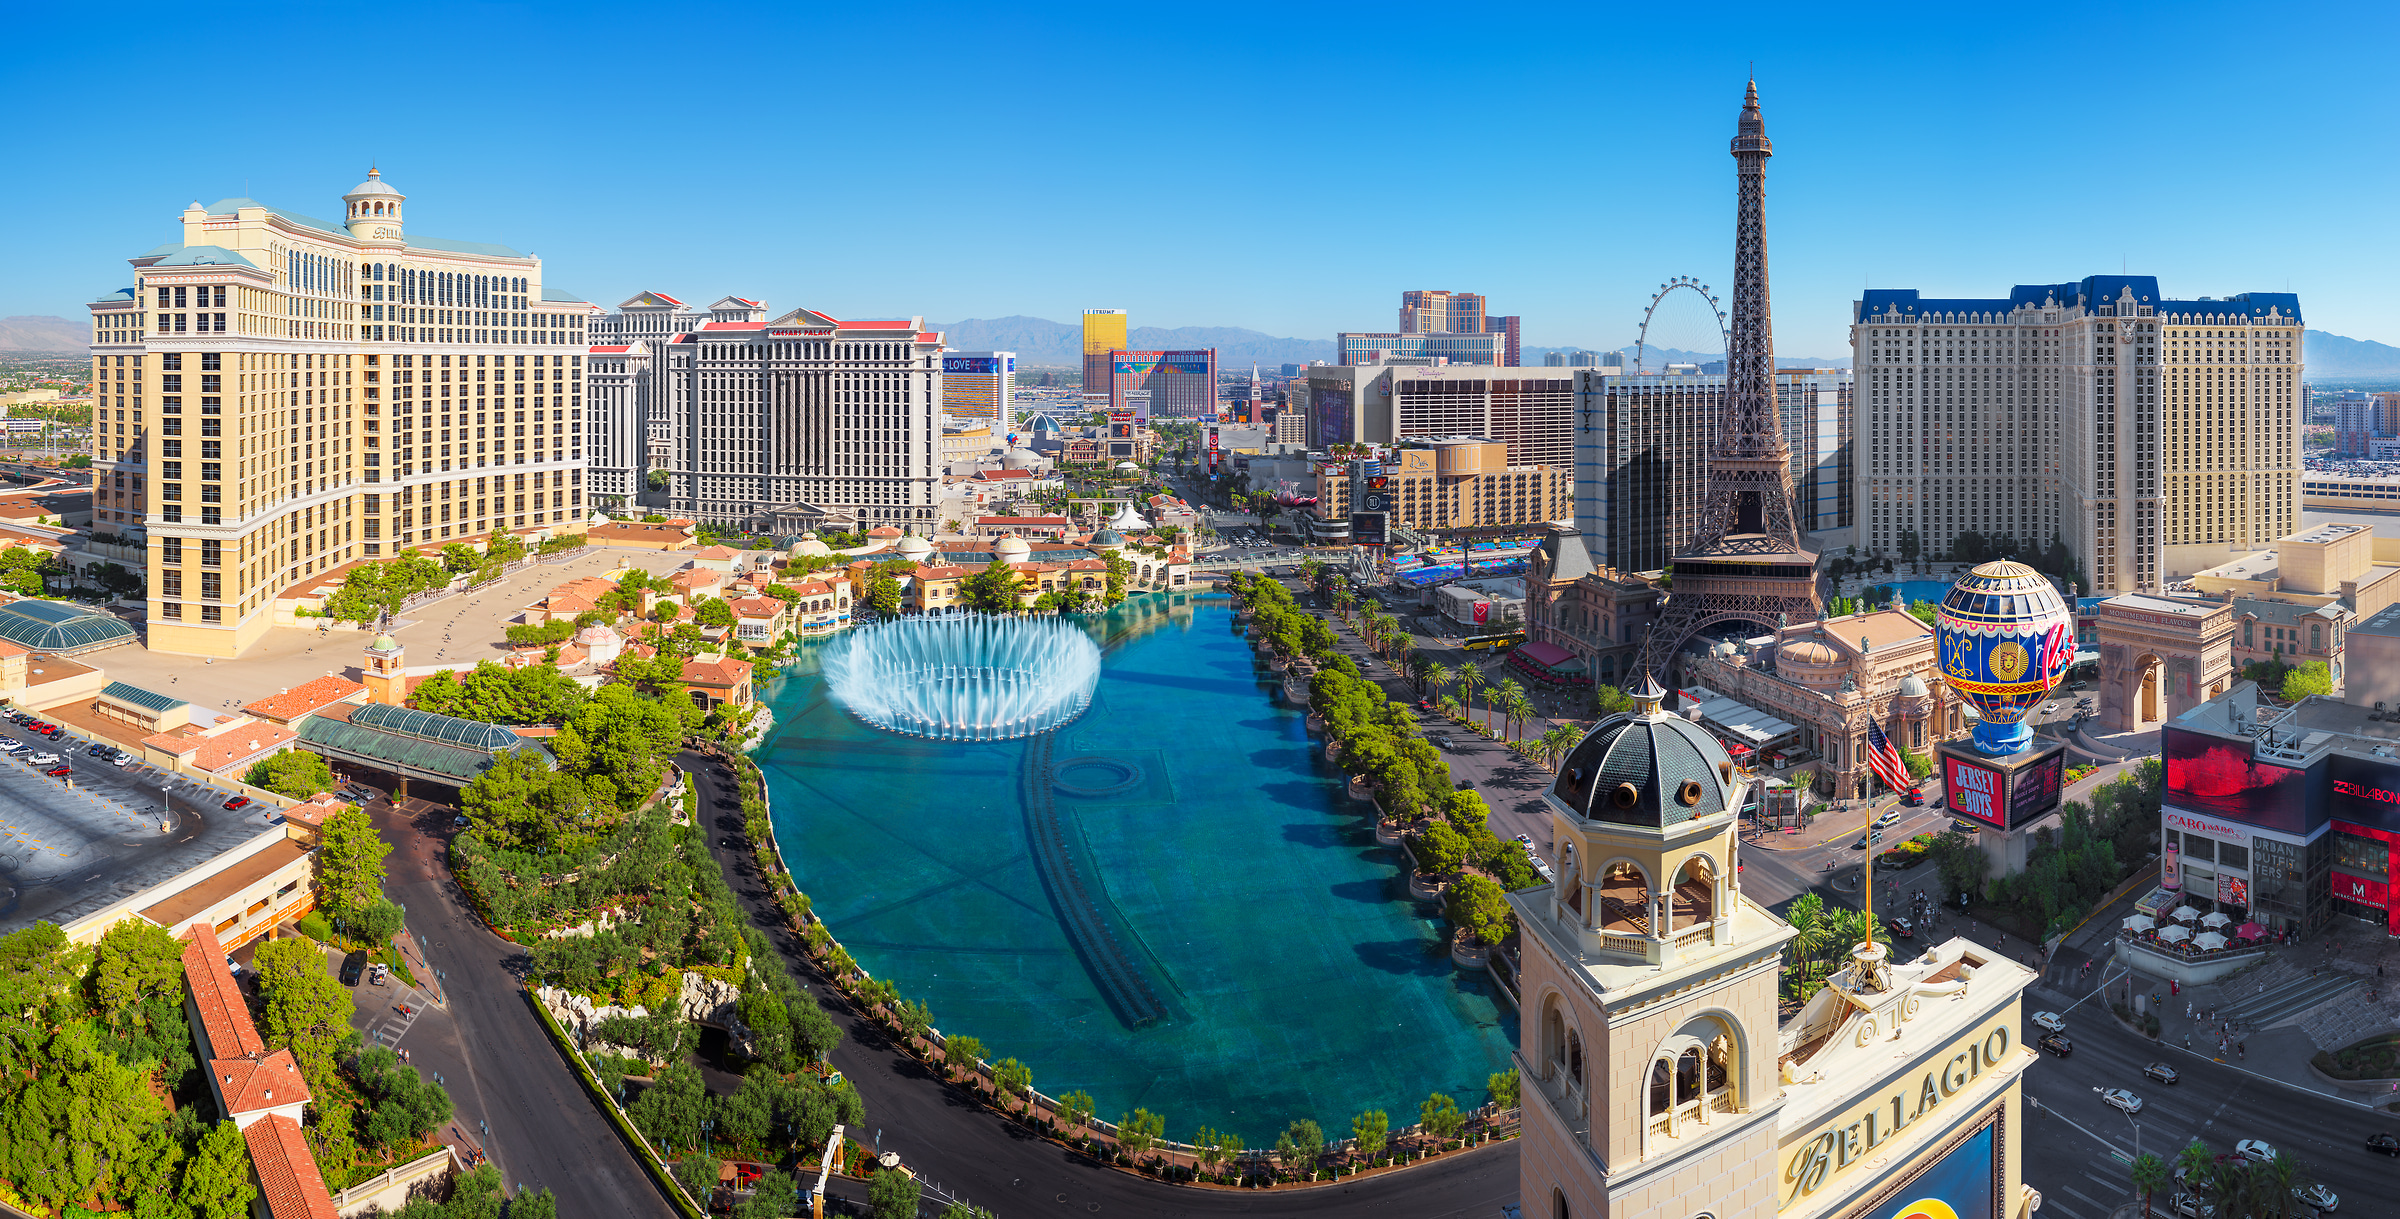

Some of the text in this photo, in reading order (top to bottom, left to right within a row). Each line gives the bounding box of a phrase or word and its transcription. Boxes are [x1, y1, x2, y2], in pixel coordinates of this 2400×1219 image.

[949, 359, 970, 370] LOVE
[1440, 591, 1459, 616] CVS
[2109, 609, 2192, 628] MONUMENTAL FLAVORS
[1678, 689, 1701, 704] BEER PARK
[1955, 764, 1994, 795] JERSEY
[1964, 788, 1993, 818] BOYS
[2167, 814, 2234, 834] CABO WABO
[2254, 839, 2294, 856] URBAN
[2254, 851, 2296, 869] OUTFIT
[2254, 863, 2282, 879] TERS
[2334, 892, 2355, 901] MIRACLE
[2356, 897, 2368, 905] MILE
[2353, 881, 2365, 898] M
[1778, 1024, 2010, 1210] BELLAGIO
